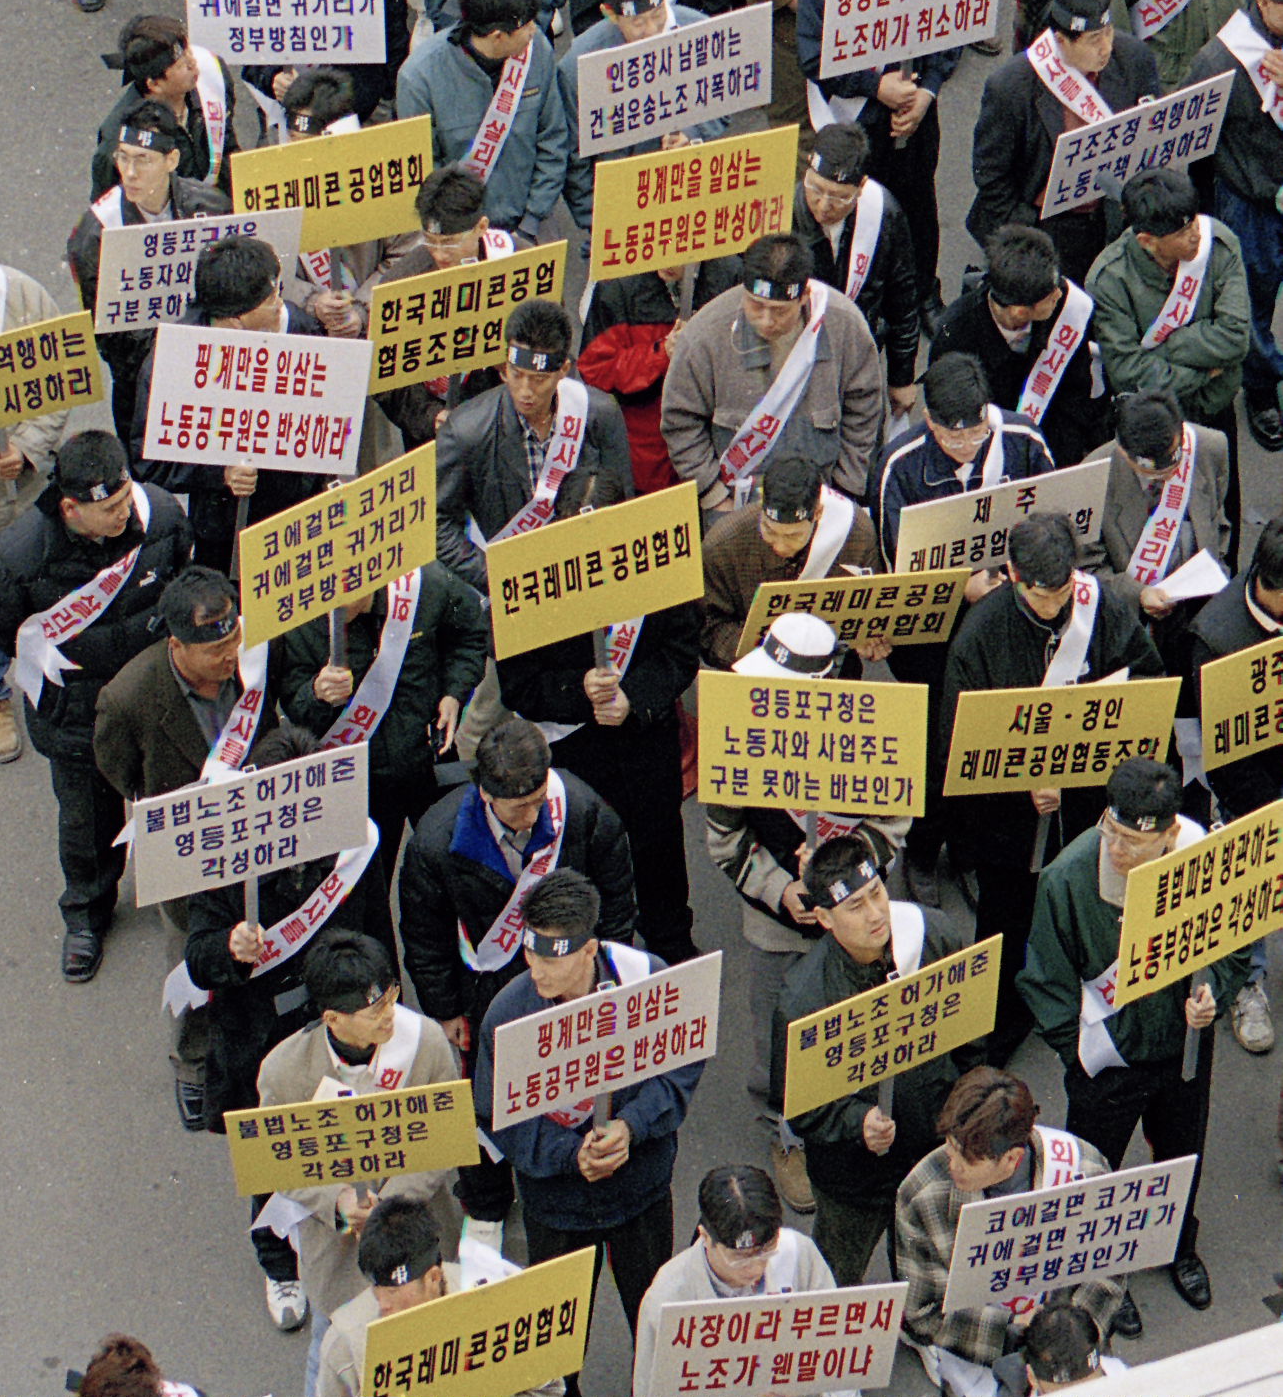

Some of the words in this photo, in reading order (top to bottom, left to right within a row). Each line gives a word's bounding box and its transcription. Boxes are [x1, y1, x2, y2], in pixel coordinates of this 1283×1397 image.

[229, 26, 353, 53] 정부방침인가
[606, 46, 672, 93] 인증장사
[679, 27, 741, 72] 남발하는
[833, 14, 910, 61] 노조허가
[591, 84, 688, 140] 건설운송노조
[696, 62, 761, 106] 자폭하라
[1065, 116, 1141, 167] 구조조정
[1148, 89, 1221, 134] 역행하는
[637, 158, 702, 209] 핑계만을
[710, 149, 761, 194] 일삼는
[602, 210, 706, 266] 노동공무원은
[714, 195, 783, 245] 반성하라
[121, 261, 192, 291] 노동자와
[382, 260, 555, 334] 한국레미콘공업
[107, 299, 139, 324] 구분
[5, 366, 92, 413] 시정하라
[194, 344, 269, 393] 핑계만을
[275, 351, 326, 397] 일삼는
[158, 403, 269, 454] 노동공무원은
[275, 413, 352, 460] 반성하라
[546, 416, 582, 489] 회사를
[264, 500, 345, 560] 코에걸면
[359, 467, 415, 517] 코거리
[253, 540, 333, 599] 귀에걸면
[346, 497, 426, 556] 귀거리가
[277, 542, 403, 622] 정부방침인가
[750, 688, 875, 724] 영등포구청은
[725, 726, 809, 760] 노동자와
[818, 733, 898, 765] 사업주도
[146, 787, 246, 833] 불법노조
[257, 757, 355, 801] 허가해준
[711, 766, 749, 796] 구분
[763, 769, 820, 801] 못하는
[831, 774, 913, 806] 바보인가
[175, 797, 322, 857] 영등포구청은
[202, 835, 298, 879] 각성하라
[1155, 848, 1216, 918] 불법파업
[1220, 820, 1279, 886] 방관하는
[280, 876, 344, 942] 회사를
[1127, 903, 1223, 987] 노동부장관은
[538, 1002, 617, 1058] 핑계만을
[627, 982, 679, 1029] 일삼는
[800, 994, 889, 1051] 불법노조
[901, 950, 988, 1005] 허가해준
[825, 993, 960, 1068] 영등포구청은
[507, 1045, 625, 1114] 노동공무원은
[634, 1016, 706, 1072] 반성하라
[848, 1031, 937, 1082] 각성하라
[239, 1108, 339, 1139] 불법노조
[355, 1091, 453, 1121] 허가해준
[271, 1121, 428, 1160] 영등포구청은
[302, 1150, 406, 1180] 각성하라
[986, 1193, 1085, 1234] 코에걸면
[1095, 1174, 1170, 1210] 코거리
[968, 1227, 1066, 1267] 귀에걸면
[1077, 1202, 1176, 1244] 귀거리가
[990, 1239, 1138, 1292] 정부방침인가
[672, 1310, 781, 1348] 사장이라
[791, 1299, 894, 1339] 부르면서
[679, 1355, 760, 1391] 노조가
[771, 1345, 873, 1385] 웬말이냐
